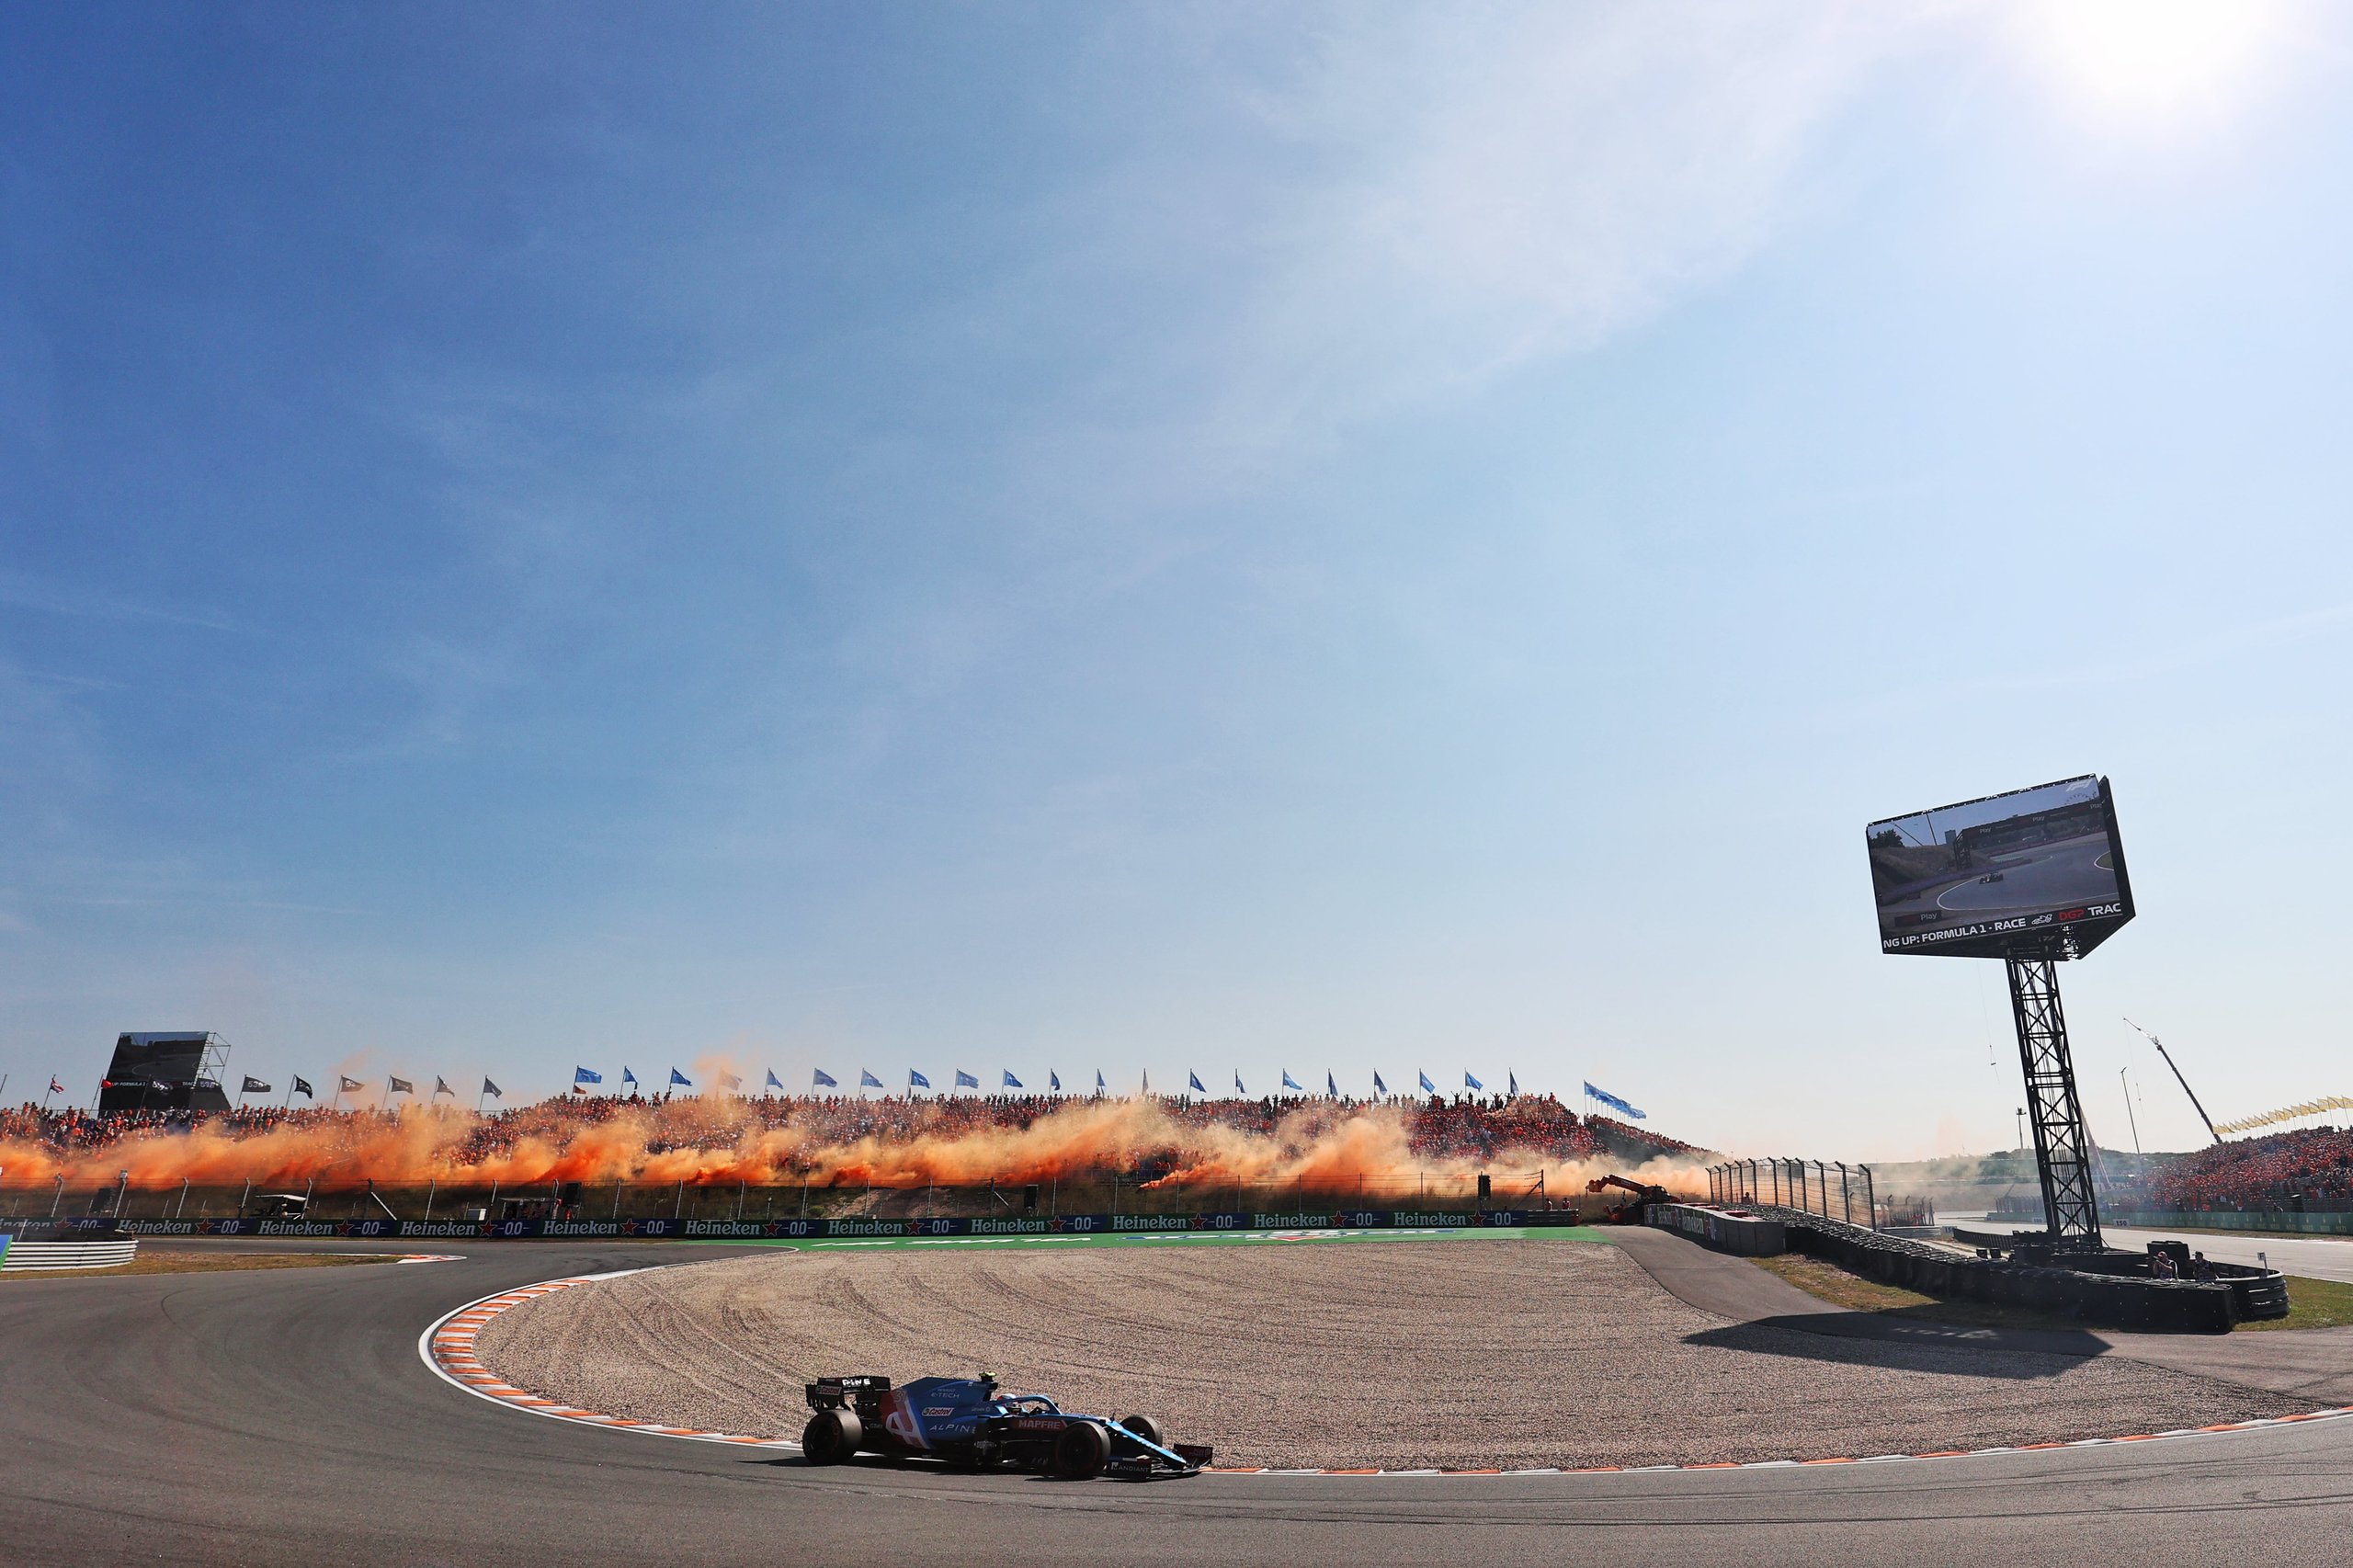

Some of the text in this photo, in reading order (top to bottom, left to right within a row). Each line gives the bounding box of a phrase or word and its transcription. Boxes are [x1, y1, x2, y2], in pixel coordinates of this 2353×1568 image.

[1902, 935, 1920, 946] UP:
[1922, 926, 1978, 942] FORMULA
[1979, 925, 1986, 934] 1
[1995, 918, 2027, 931] RACE
[2087, 903, 2121, 916] TRAC
[1920, 913, 1938, 921] Play
[970, 1218, 1045, 1234] Heineken
[1112, 1214, 1187, 1230] Heineken
[1254, 1212, 1328, 1228] Heineken
[1393, 1210, 1467, 1227] Heineken
[117, 1220, 192, 1235] Heineken
[258, 1220, 334, 1235] Heineken
[400, 1221, 475, 1236] Heineken
[542, 1221, 618, 1235] Heineken
[685, 1220, 761, 1235] Heineken
[827, 1220, 903, 1235] Heineken
[928, 1407, 951, 1415] Castrol
[929, 1424, 977, 1435] ALPINE
[1018, 1419, 1061, 1430] MAPFRE
